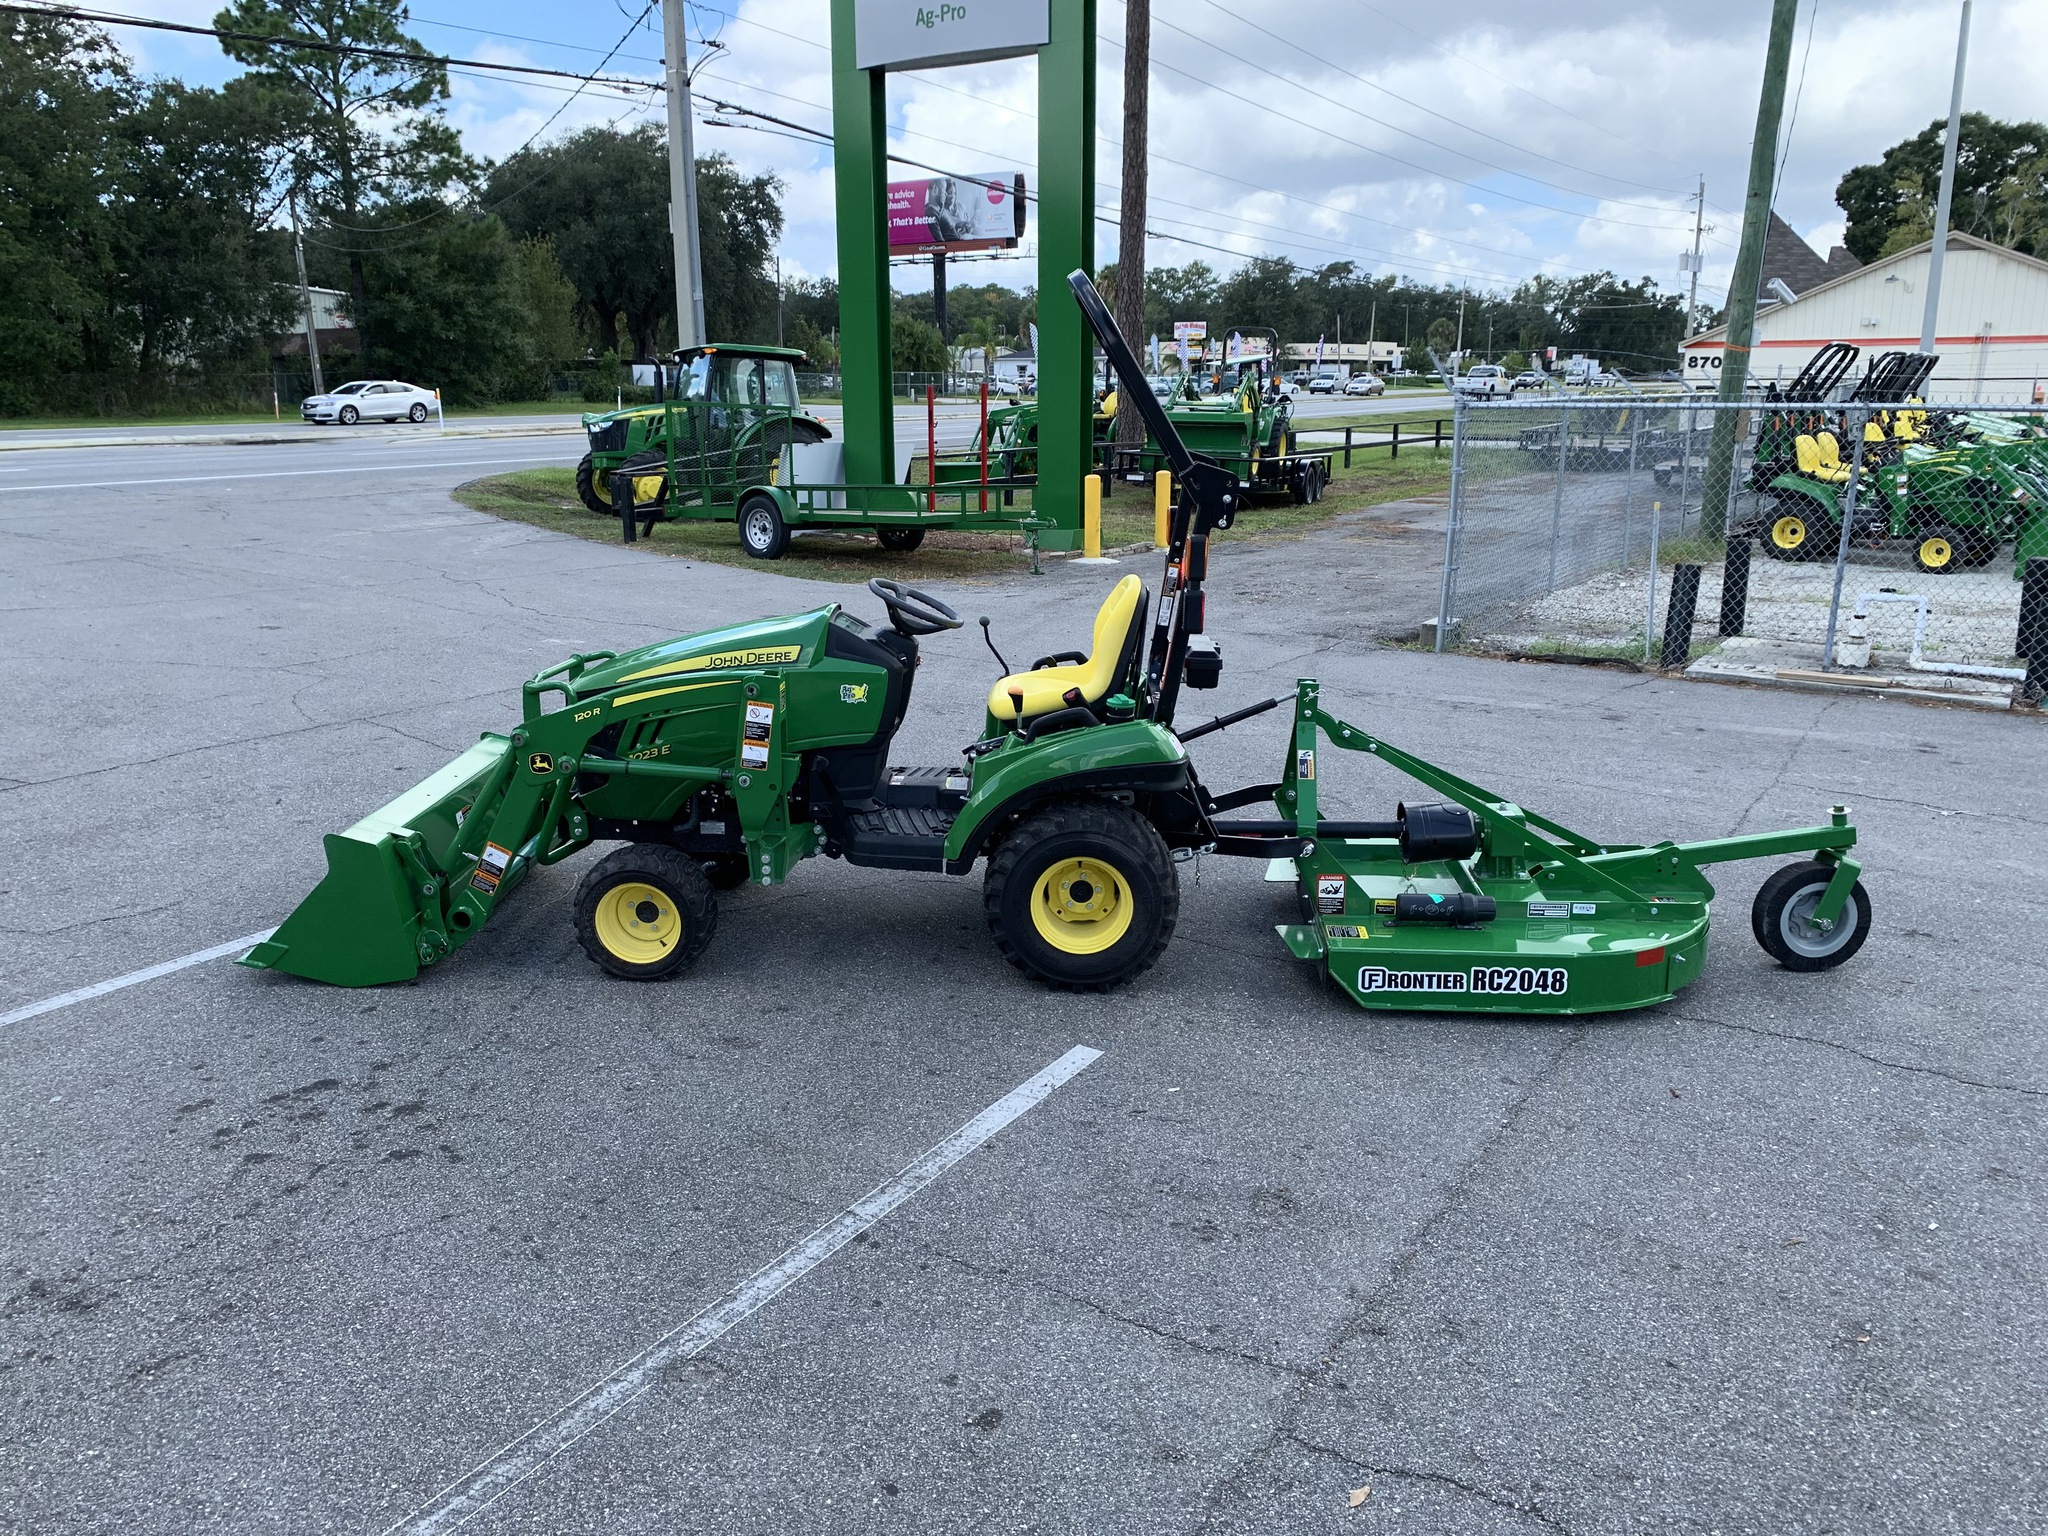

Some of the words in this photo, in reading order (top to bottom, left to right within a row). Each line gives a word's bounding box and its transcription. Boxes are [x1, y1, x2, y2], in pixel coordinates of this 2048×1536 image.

[915, 4, 966, 28] Ag-Pro
[894, 190, 915, 199] advice
[892, 217, 914, 227] That's
[914, 216, 936, 225] Better.
[1688, 356, 1723, 369] 870
[705, 655, 743, 668] JOHN
[746, 652, 792, 664] DEERE
[574, 710, 592, 723] 120
[593, 707, 601, 716] R
[661, 744, 671, 755] E
[1361, 968, 1464, 990] FRONTIER
[1472, 968, 1566, 992] RC2048
